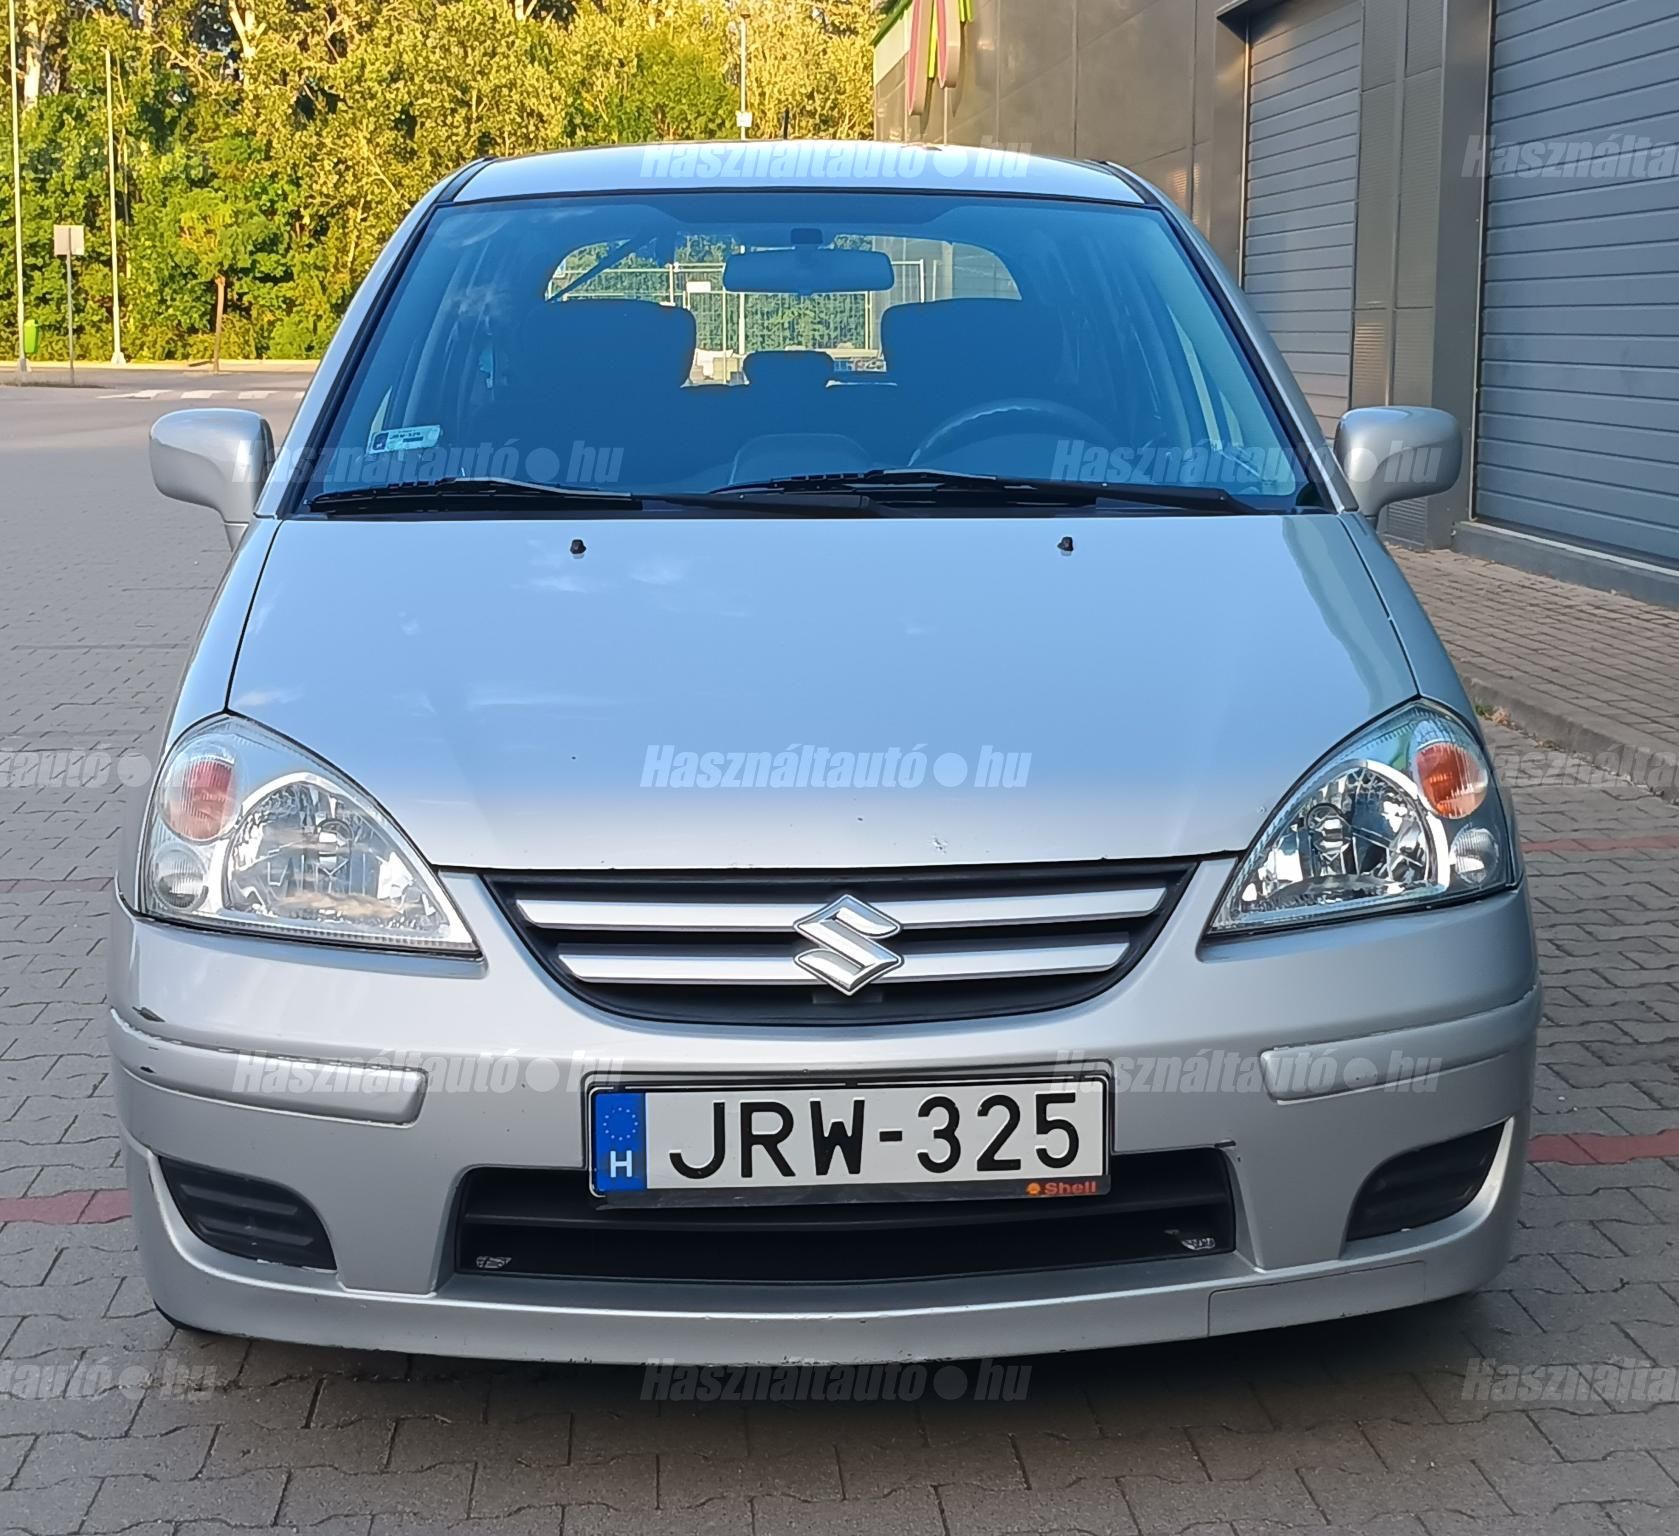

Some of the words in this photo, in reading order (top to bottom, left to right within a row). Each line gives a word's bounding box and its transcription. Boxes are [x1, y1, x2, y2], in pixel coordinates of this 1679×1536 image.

[669, 1091, 1080, 1180] JRW-325
[609, 1149, 633, 1178] H
[1044, 1181, 1096, 1195] Shell
